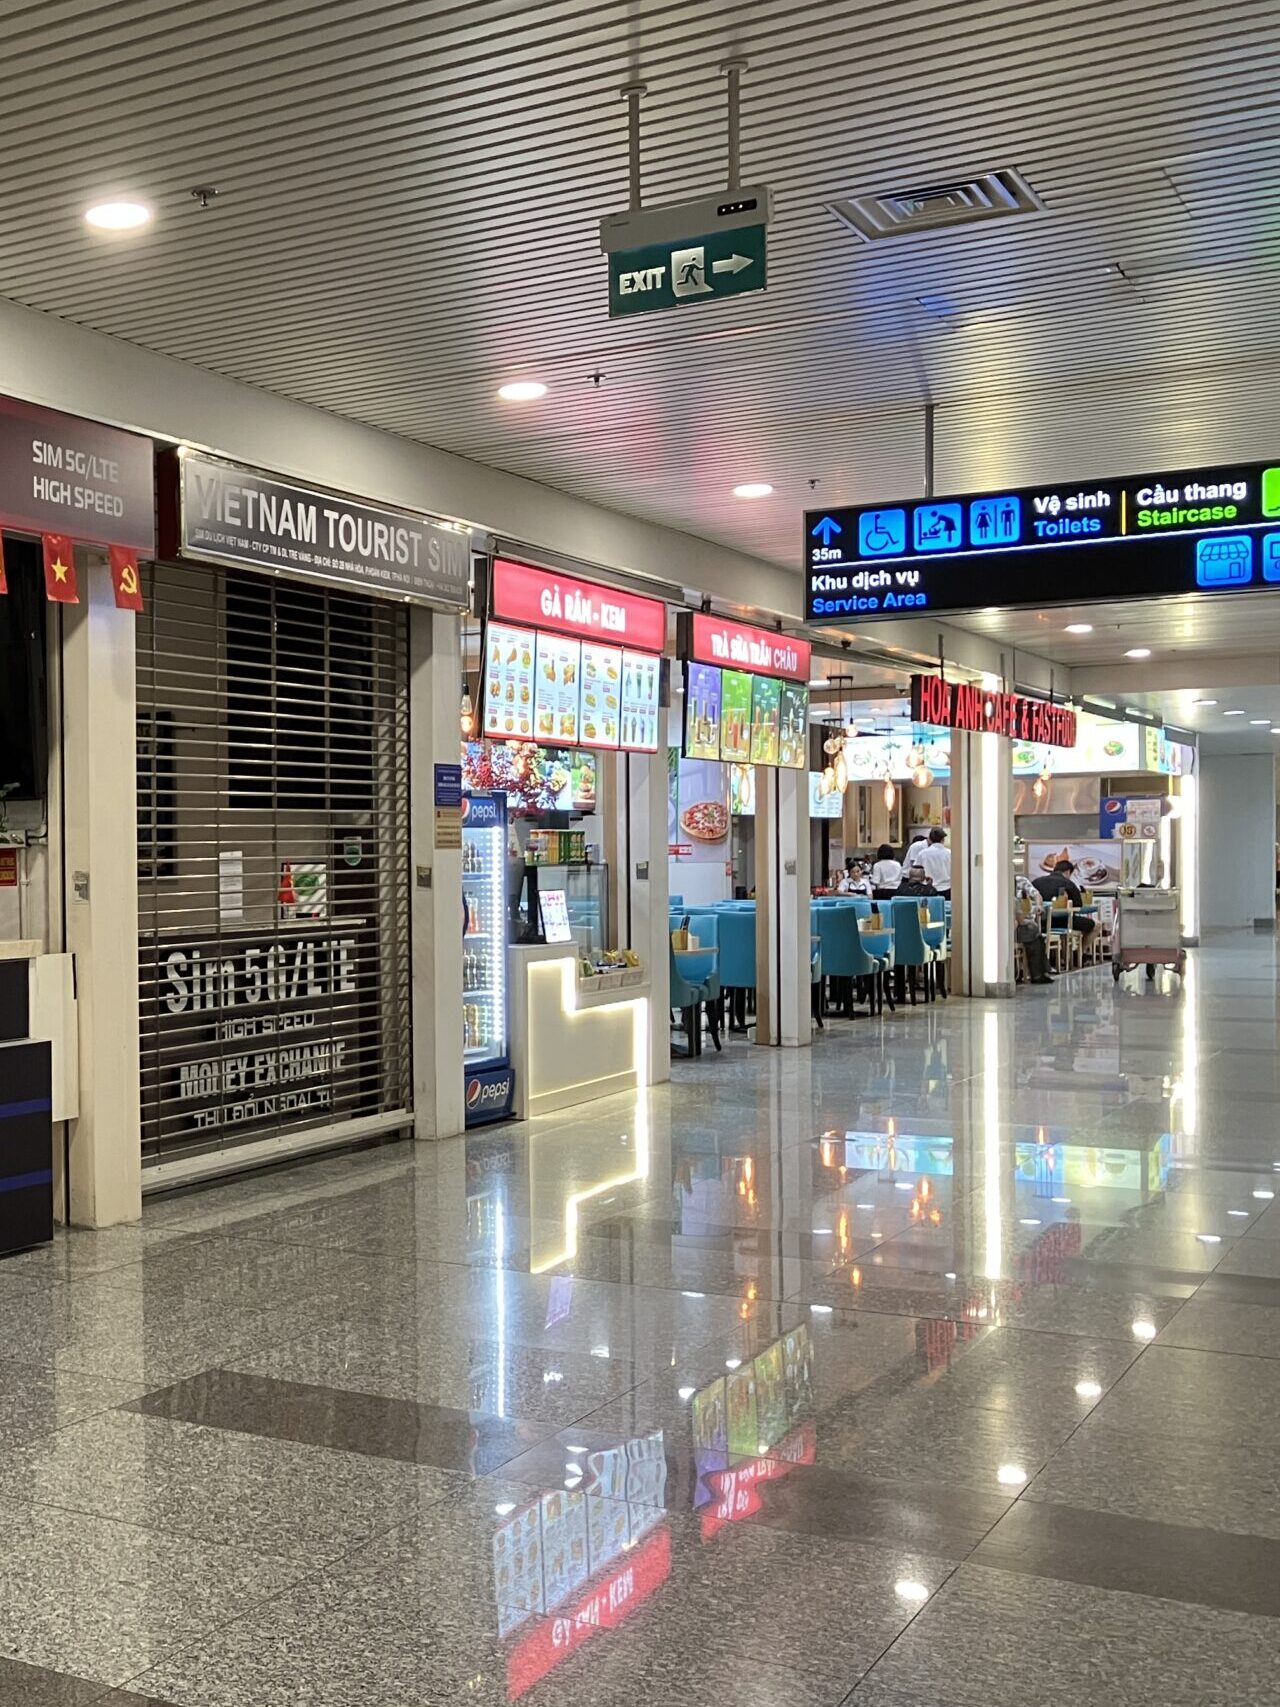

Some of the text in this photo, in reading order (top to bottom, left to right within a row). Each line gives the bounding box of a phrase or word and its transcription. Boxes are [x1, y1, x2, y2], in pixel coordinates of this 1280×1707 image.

[619, 266, 666, 295] EXIT
[32, 439, 120, 484] SIM 5G/LTE
[32, 475, 124, 518] HIGH SPEED
[1034, 491, 1111, 517] Vệ sinh
[1136, 480, 1247, 506] Cầu thang
[193, 474, 318, 545] VIETNAM
[323, 509, 422, 568] TOURIST
[427, 536, 464, 578] SIM
[1034, 517, 1101, 538] Toilets
[1136, 505, 1238, 528] Staircase
[811, 547, 842, 561] 35m
[811, 570, 919, 593] Khu dịch vụ
[540, 583, 562, 619] GÀ
[563, 590, 592, 626] RÁN
[600, 602, 626, 633] KEM
[812, 591, 927, 614] Service Area
[773, 645, 798, 672] CHÂU
[921, 674, 951, 726] HOA
[956, 684, 983, 732] ANH
[471, 802, 497, 821] pepsi
[166, 950, 236, 1014] Sim
[180, 1055, 249, 1099] MONEY
[480, 1077, 511, 1102] pepsi
